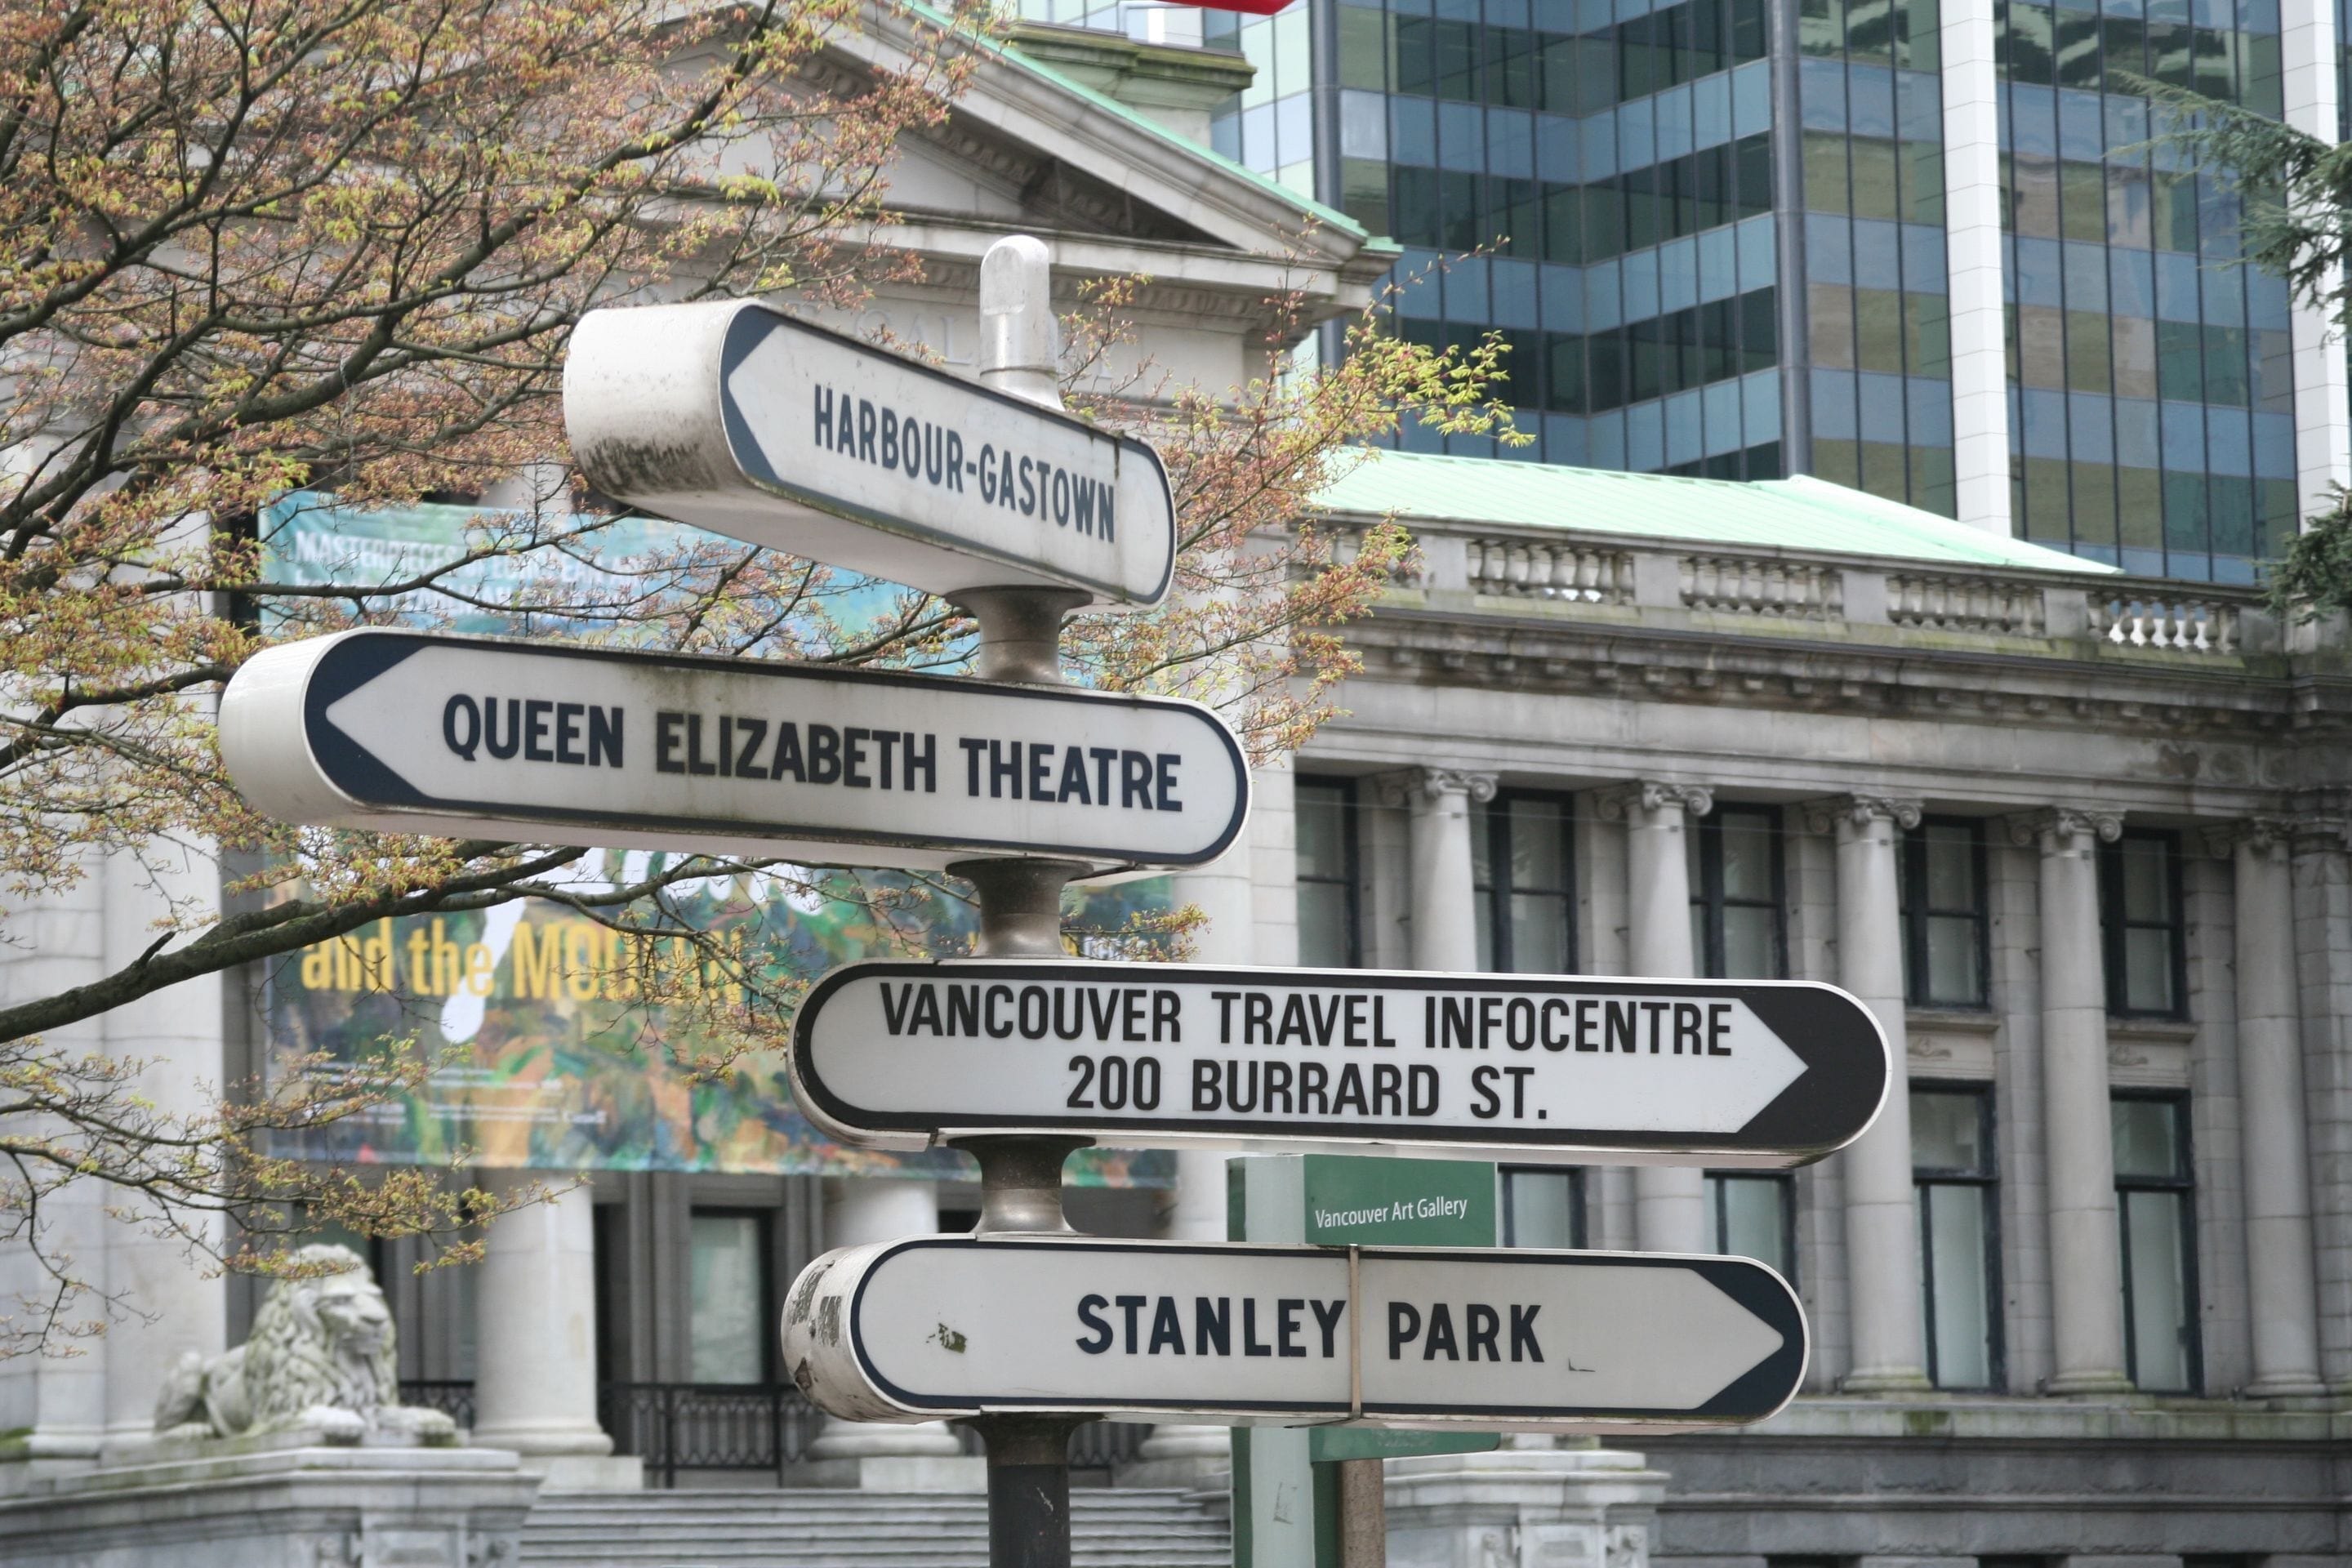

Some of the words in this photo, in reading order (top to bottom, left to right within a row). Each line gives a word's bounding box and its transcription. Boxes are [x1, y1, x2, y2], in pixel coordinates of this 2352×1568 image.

[815, 384, 1114, 543] HARBOUR-GASTOWN
[443, 693, 624, 768] QUEEN
[657, 710, 936, 793] ELIZABETH
[959, 737, 1183, 812] THEATRE
[301, 915, 395, 993] and
[408, 917, 495, 996] the
[879, 981, 1181, 1043] VANCOUVER
[1211, 988, 1396, 1048] TRAVEL
[1425, 996, 1733, 1057] INFOCENTRE
[1067, 1055, 1161, 1111] 200
[1192, 1058, 1440, 1117] BURRARD
[1470, 1065, 1547, 1120] ST.
[1315, 1207, 1388, 1228] Vancouver
[1392, 1201, 1414, 1221] Art
[1417, 1196, 1468, 1219] Gallery
[1076, 1294, 1347, 1358] STANLEY
[1388, 1301, 1545, 1363] PARK
